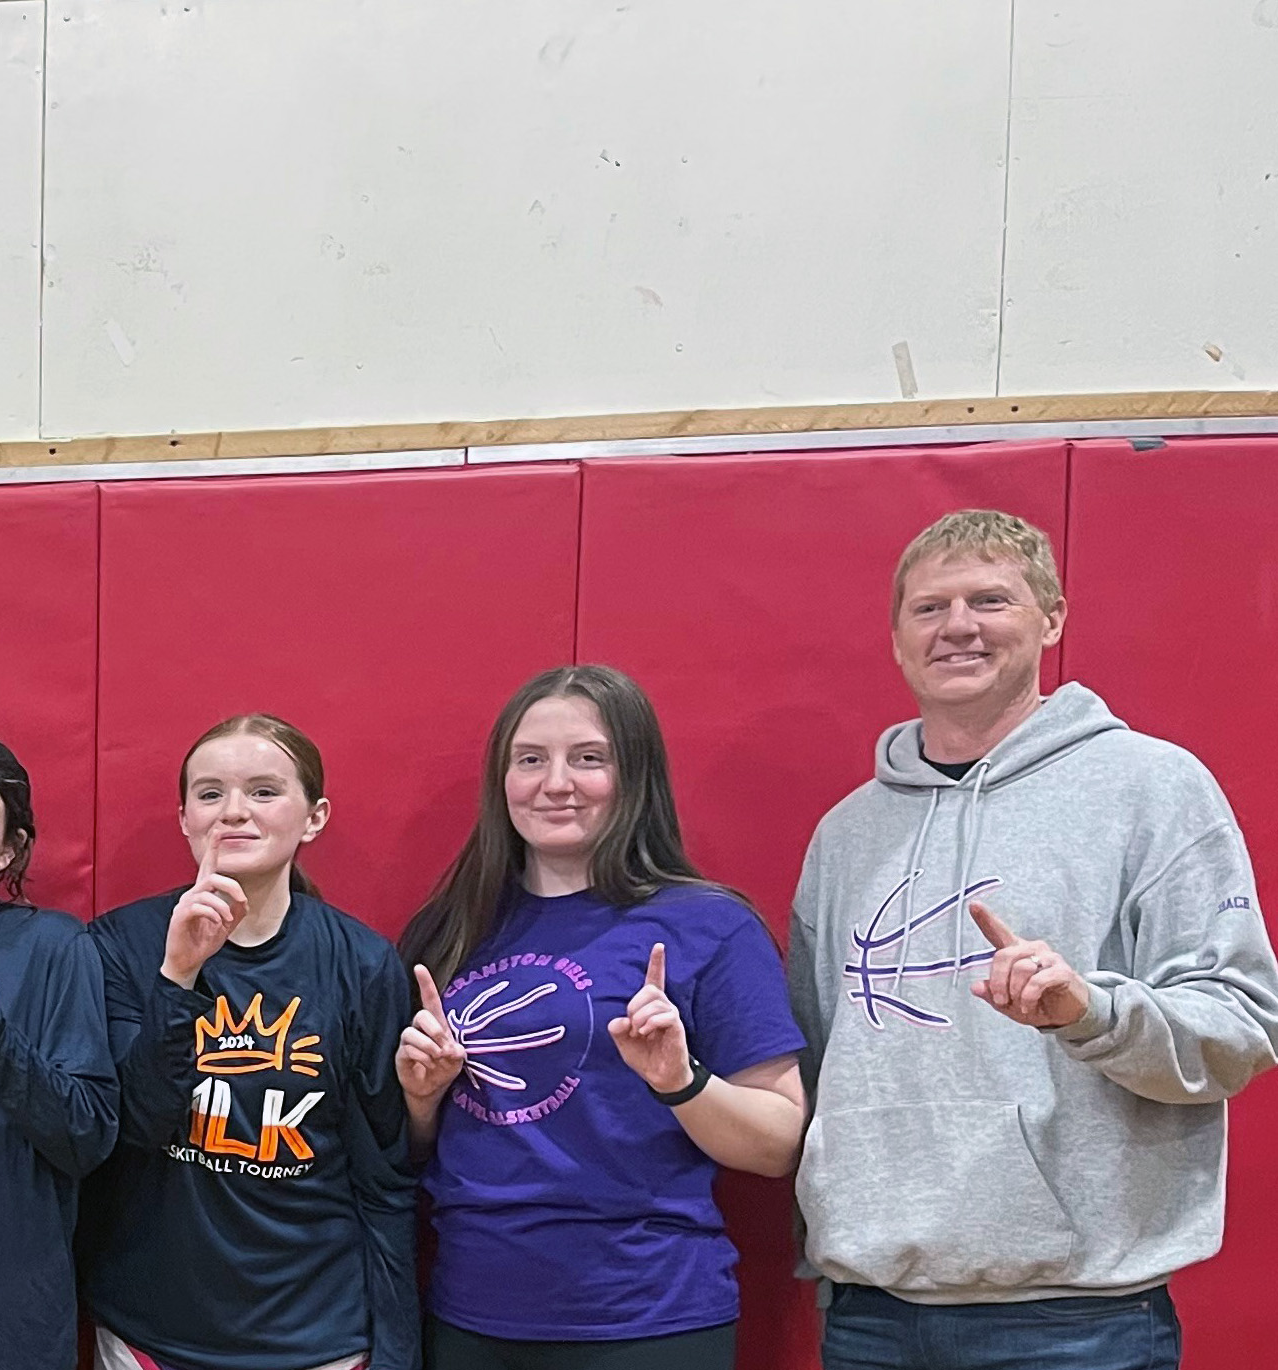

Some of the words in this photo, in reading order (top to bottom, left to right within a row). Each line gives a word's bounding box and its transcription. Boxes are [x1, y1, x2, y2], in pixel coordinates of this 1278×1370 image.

[443, 952, 554, 999] CRANSTON
[554, 957, 593, 991] GIRLS
[217, 1035, 255, 1051] 2024
[238, 1160, 314, 1179] TOURNEY
